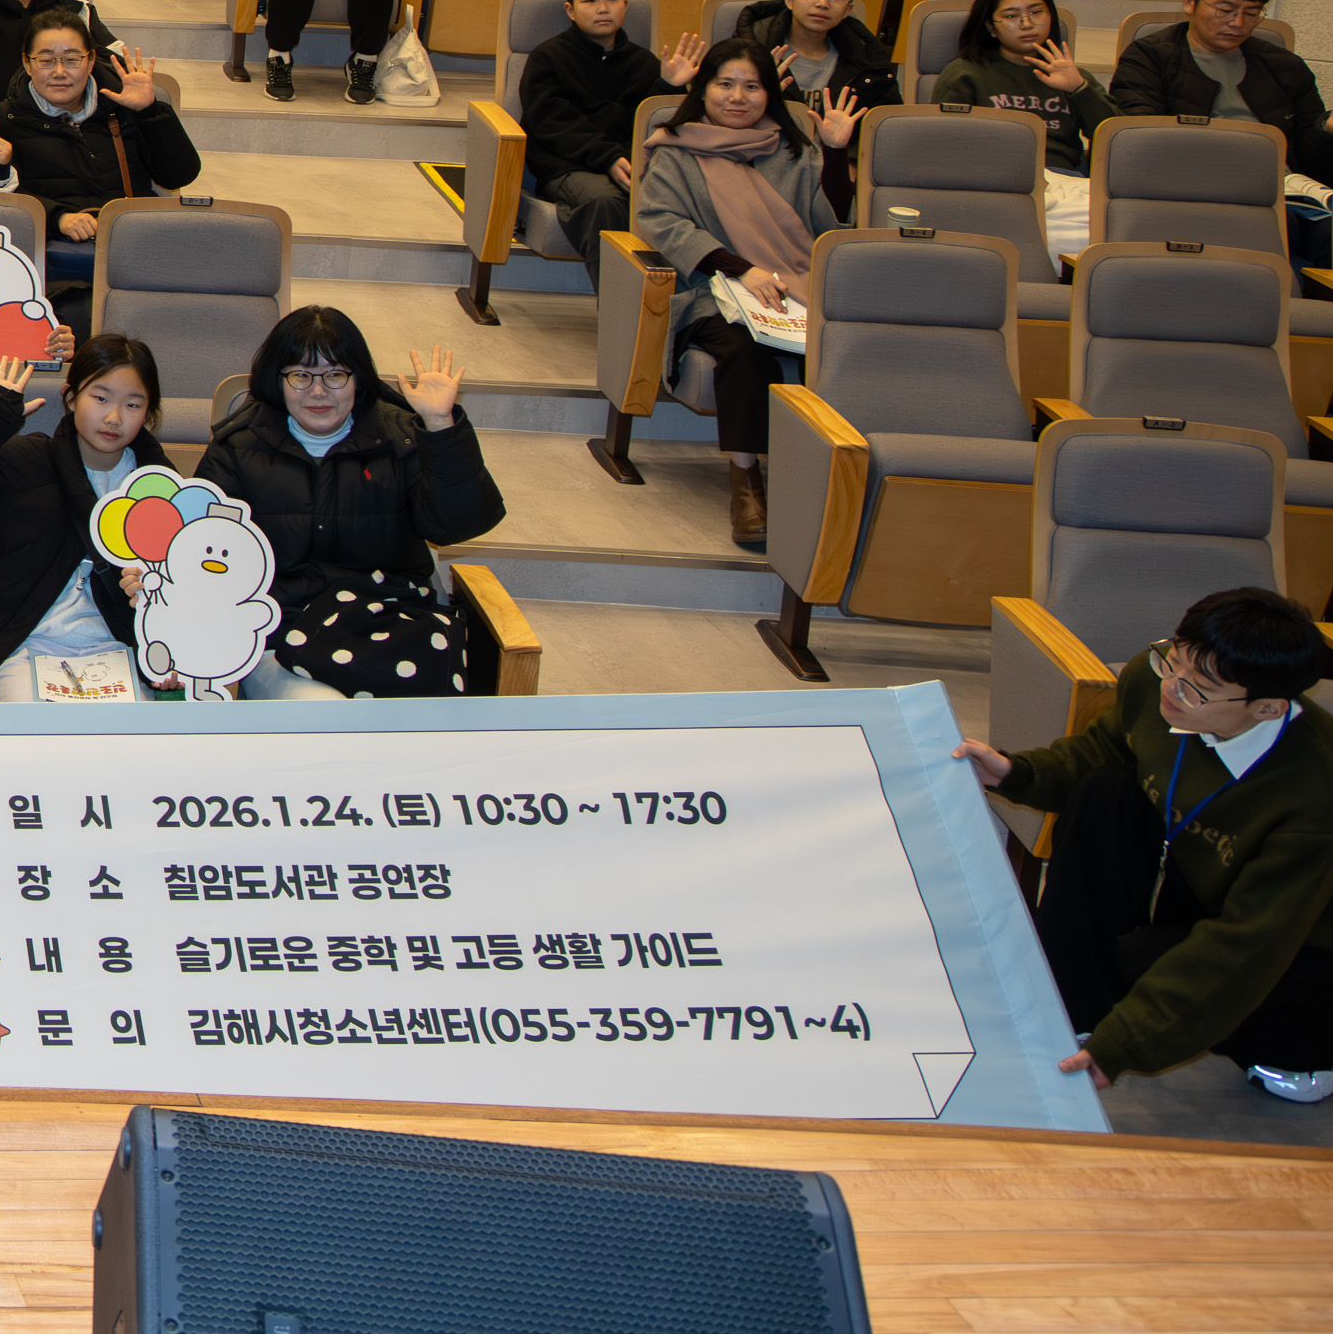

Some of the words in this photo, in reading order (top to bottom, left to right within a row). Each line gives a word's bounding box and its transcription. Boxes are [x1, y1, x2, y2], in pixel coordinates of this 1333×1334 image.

[452, 792, 570, 826] 10:30
[612, 790, 728, 826] 17:30
[163, 864, 340, 902] 칠암도서관
[346, 863, 452, 901] 공연장
[174, 935, 320, 974] 슬기로운
[326, 935, 400, 973] 중학
[405, 934, 445, 972] 및
[450, 933, 524, 971] 고등
[532, 931, 606, 971] 생활
[609, 931, 724, 969] 가이드
